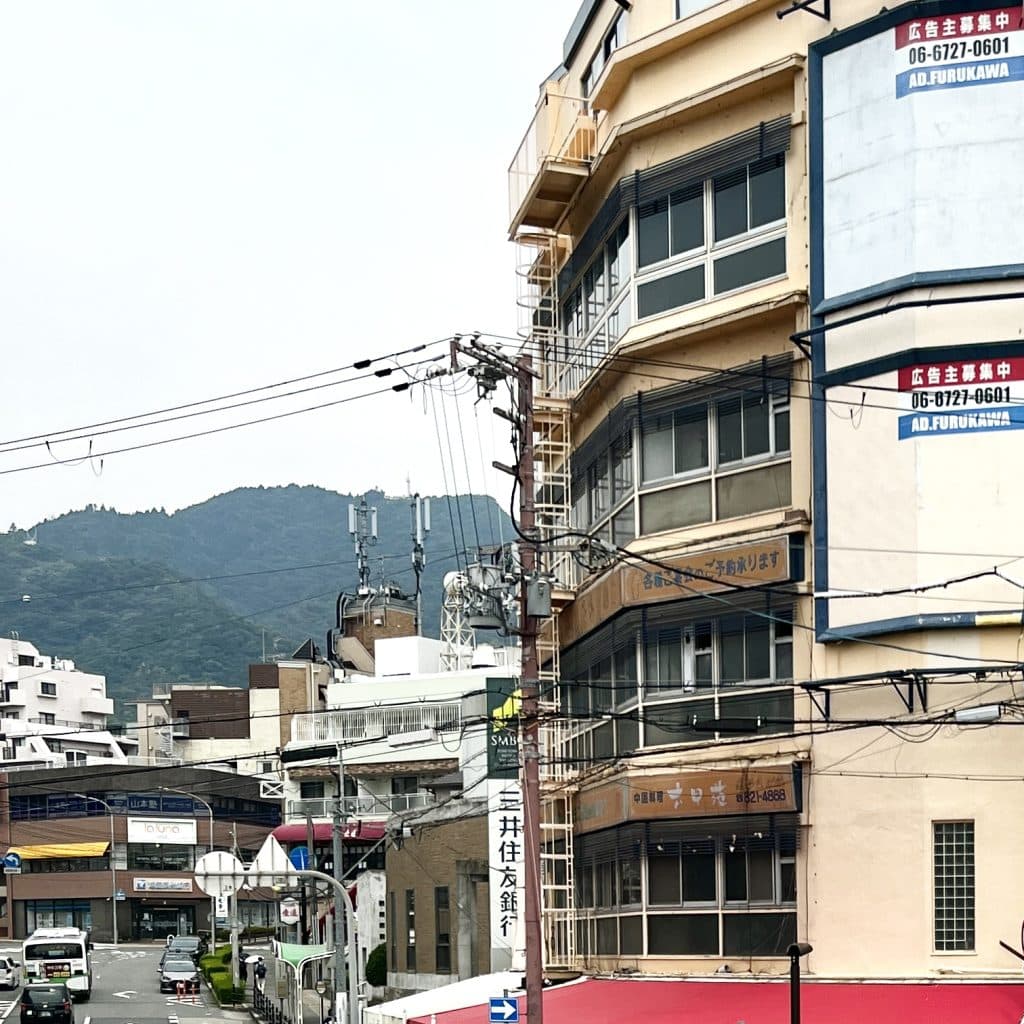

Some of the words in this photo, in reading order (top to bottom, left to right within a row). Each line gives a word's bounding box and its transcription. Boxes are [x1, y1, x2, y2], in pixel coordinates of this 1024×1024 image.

[908, 11, 1009, 40] 広告主募集中
[909, 36, 1009, 65] 06-6727-0601
[908, 62, 1009, 89] AD.FURUKAWA
[911, 361, 1011, 386] 広告主募集中
[911, 386, 1011, 409] 06-6727-0601
[911, 411, 1011, 433] AD.FURUKAWA
